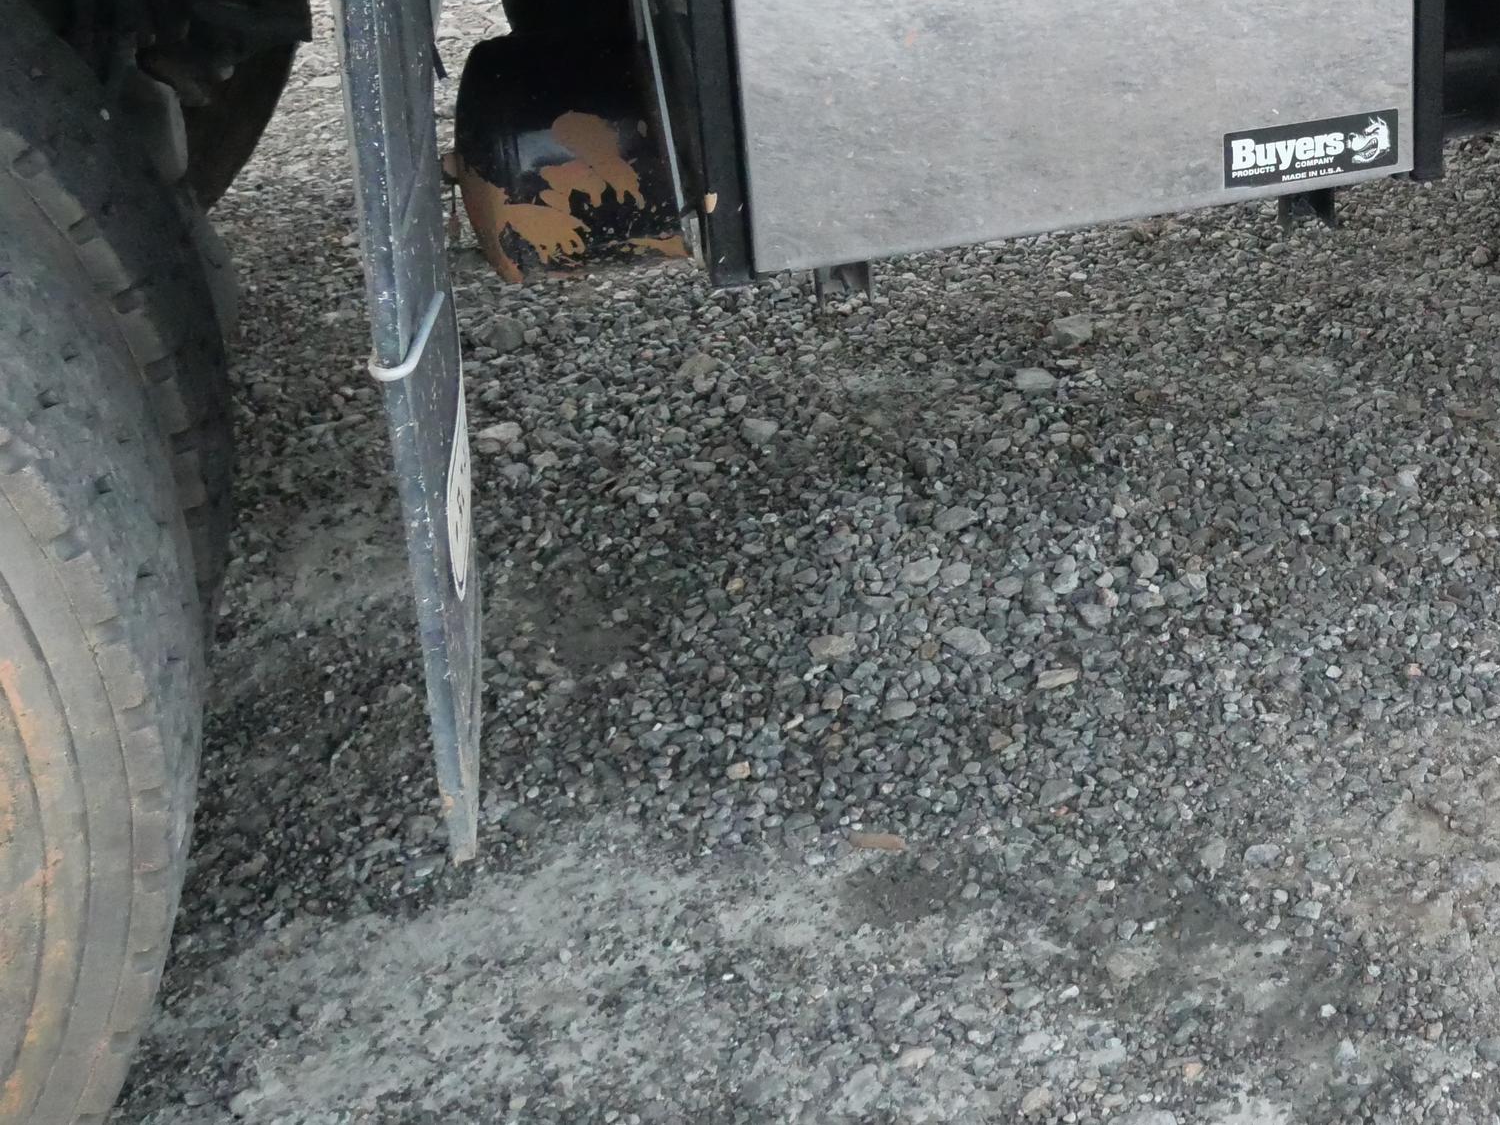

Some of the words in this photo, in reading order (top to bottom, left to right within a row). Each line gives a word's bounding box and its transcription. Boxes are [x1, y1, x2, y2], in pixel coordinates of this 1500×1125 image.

[1231, 132, 1345, 171] Buyers
[1232, 165, 1276, 179] PRODUCTS
[1295, 156, 1335, 169] COMPANY
[1281, 172, 1307, 182] MADE
[1308, 170, 1318, 178] IN
[1319, 166, 1345, 177] U.S.A.
